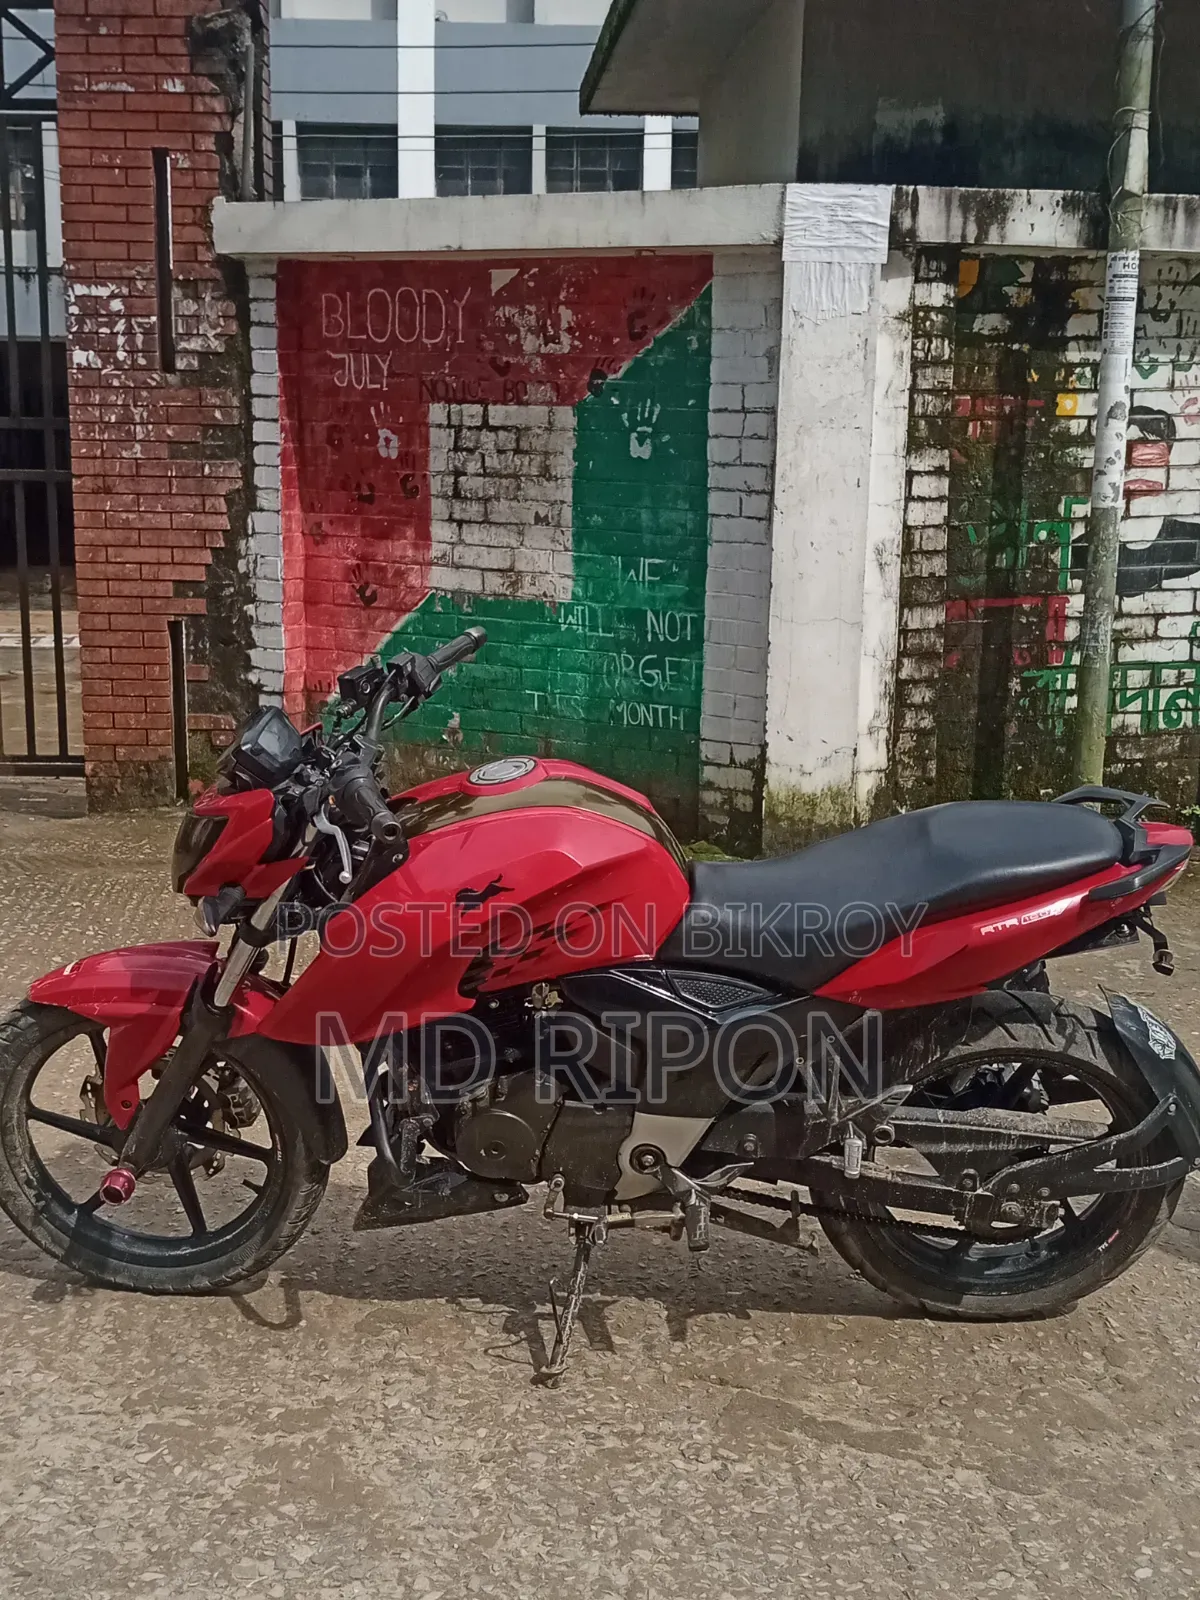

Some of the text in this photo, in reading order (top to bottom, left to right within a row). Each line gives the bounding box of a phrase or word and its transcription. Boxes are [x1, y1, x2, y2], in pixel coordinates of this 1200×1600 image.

[321, 286, 472, 345] BLOODY
[326, 350, 393, 391] JULY
[646, 608, 699, 643] NOT
[600, 648, 702, 692] ORGET
[608, 698, 685, 730] MONTH
[980, 918, 1020, 936] RTR
